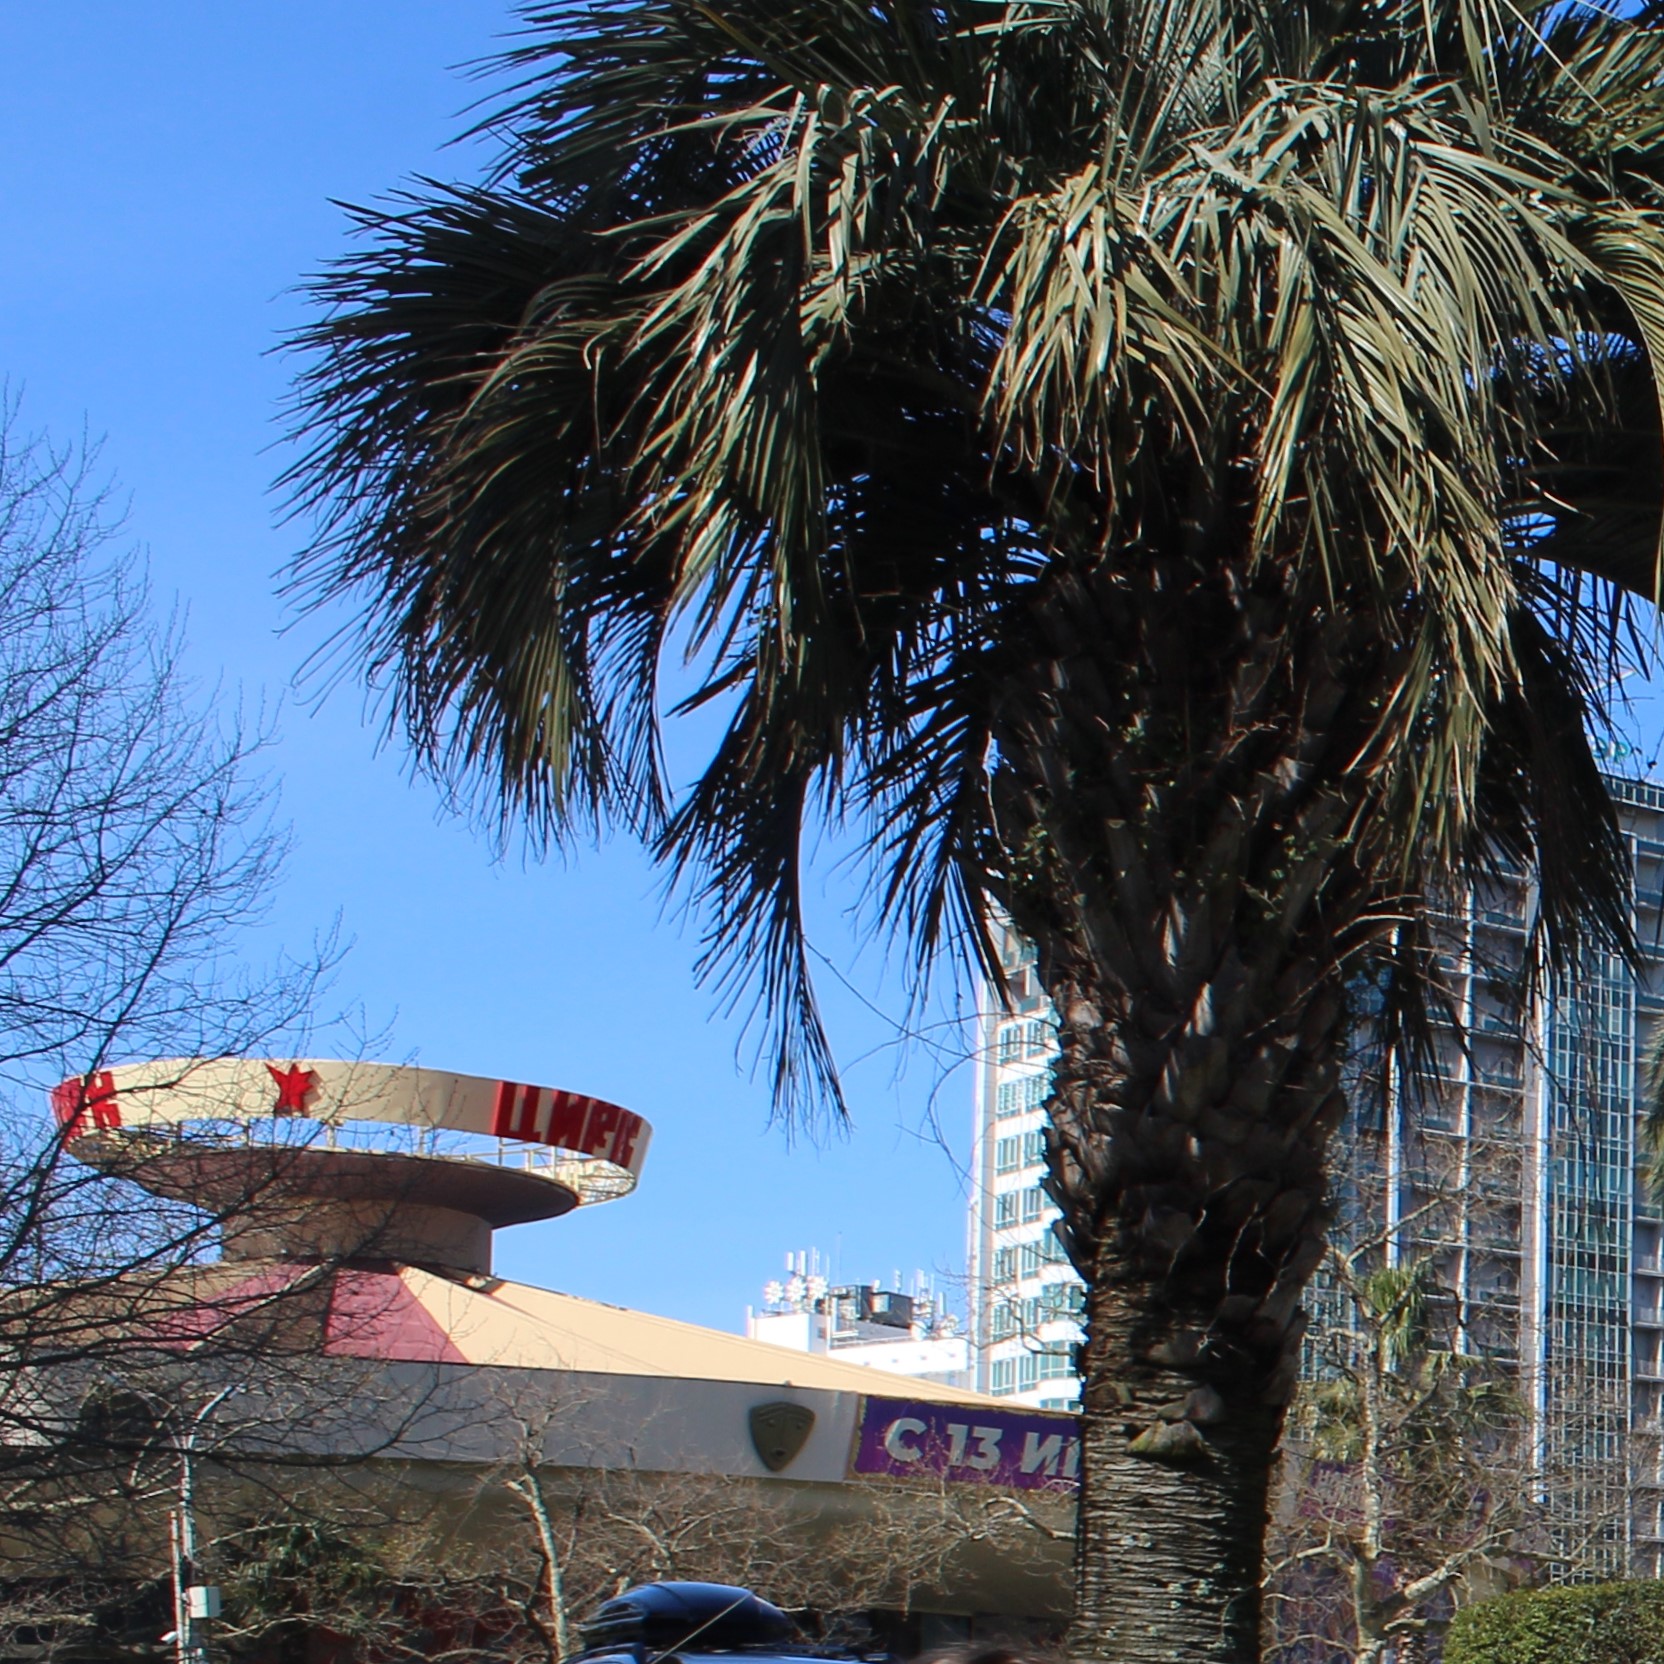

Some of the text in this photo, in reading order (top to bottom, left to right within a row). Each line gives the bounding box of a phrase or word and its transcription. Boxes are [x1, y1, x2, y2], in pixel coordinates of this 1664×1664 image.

[493, 1080, 644, 1169] ЦИРК
[884, 1417, 927, 1462] С
[946, 1423, 1003, 1470] 13
